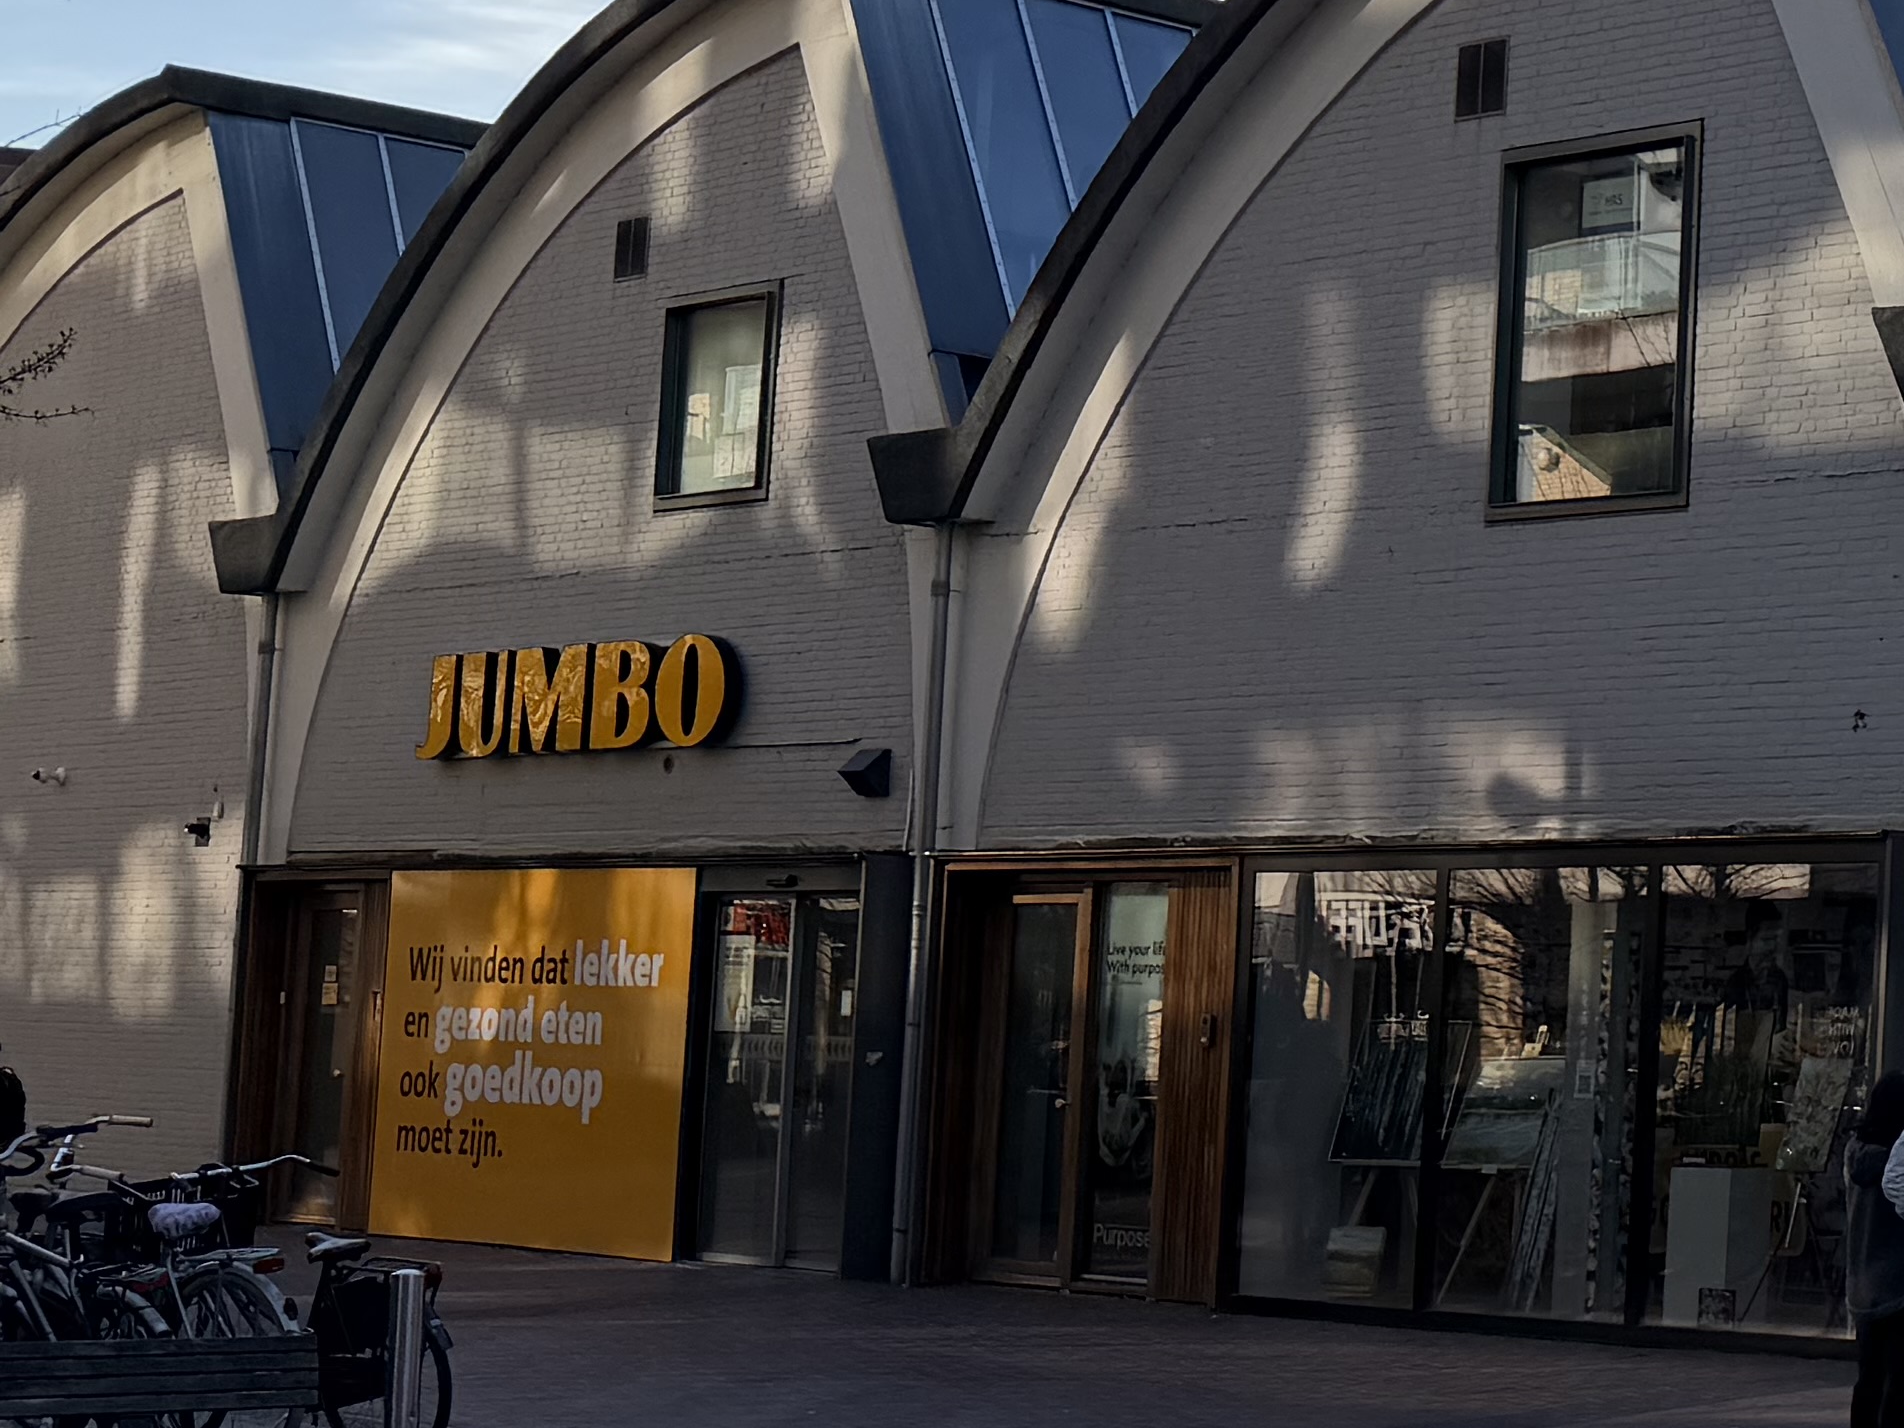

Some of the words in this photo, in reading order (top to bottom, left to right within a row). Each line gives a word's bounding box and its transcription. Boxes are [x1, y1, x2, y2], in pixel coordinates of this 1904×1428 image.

[415, 633, 727, 760] JUMBO
[409, 944, 445, 994] Wij
[449, 944, 525, 984] vinden
[531, 945, 570, 986] dat
[574, 938, 665, 988] lekker
[1106, 959, 1130, 973] With
[1128, 945, 1151, 961] your
[403, 1010, 430, 1038] en
[433, 994, 535, 1055] gezond
[540, 999, 604, 1046] eten
[399, 1059, 441, 1099] ook
[443, 1049, 604, 1126] goedkoop
[395, 1118, 453, 1155] moet
[458, 1117, 504, 1169] zijn.
